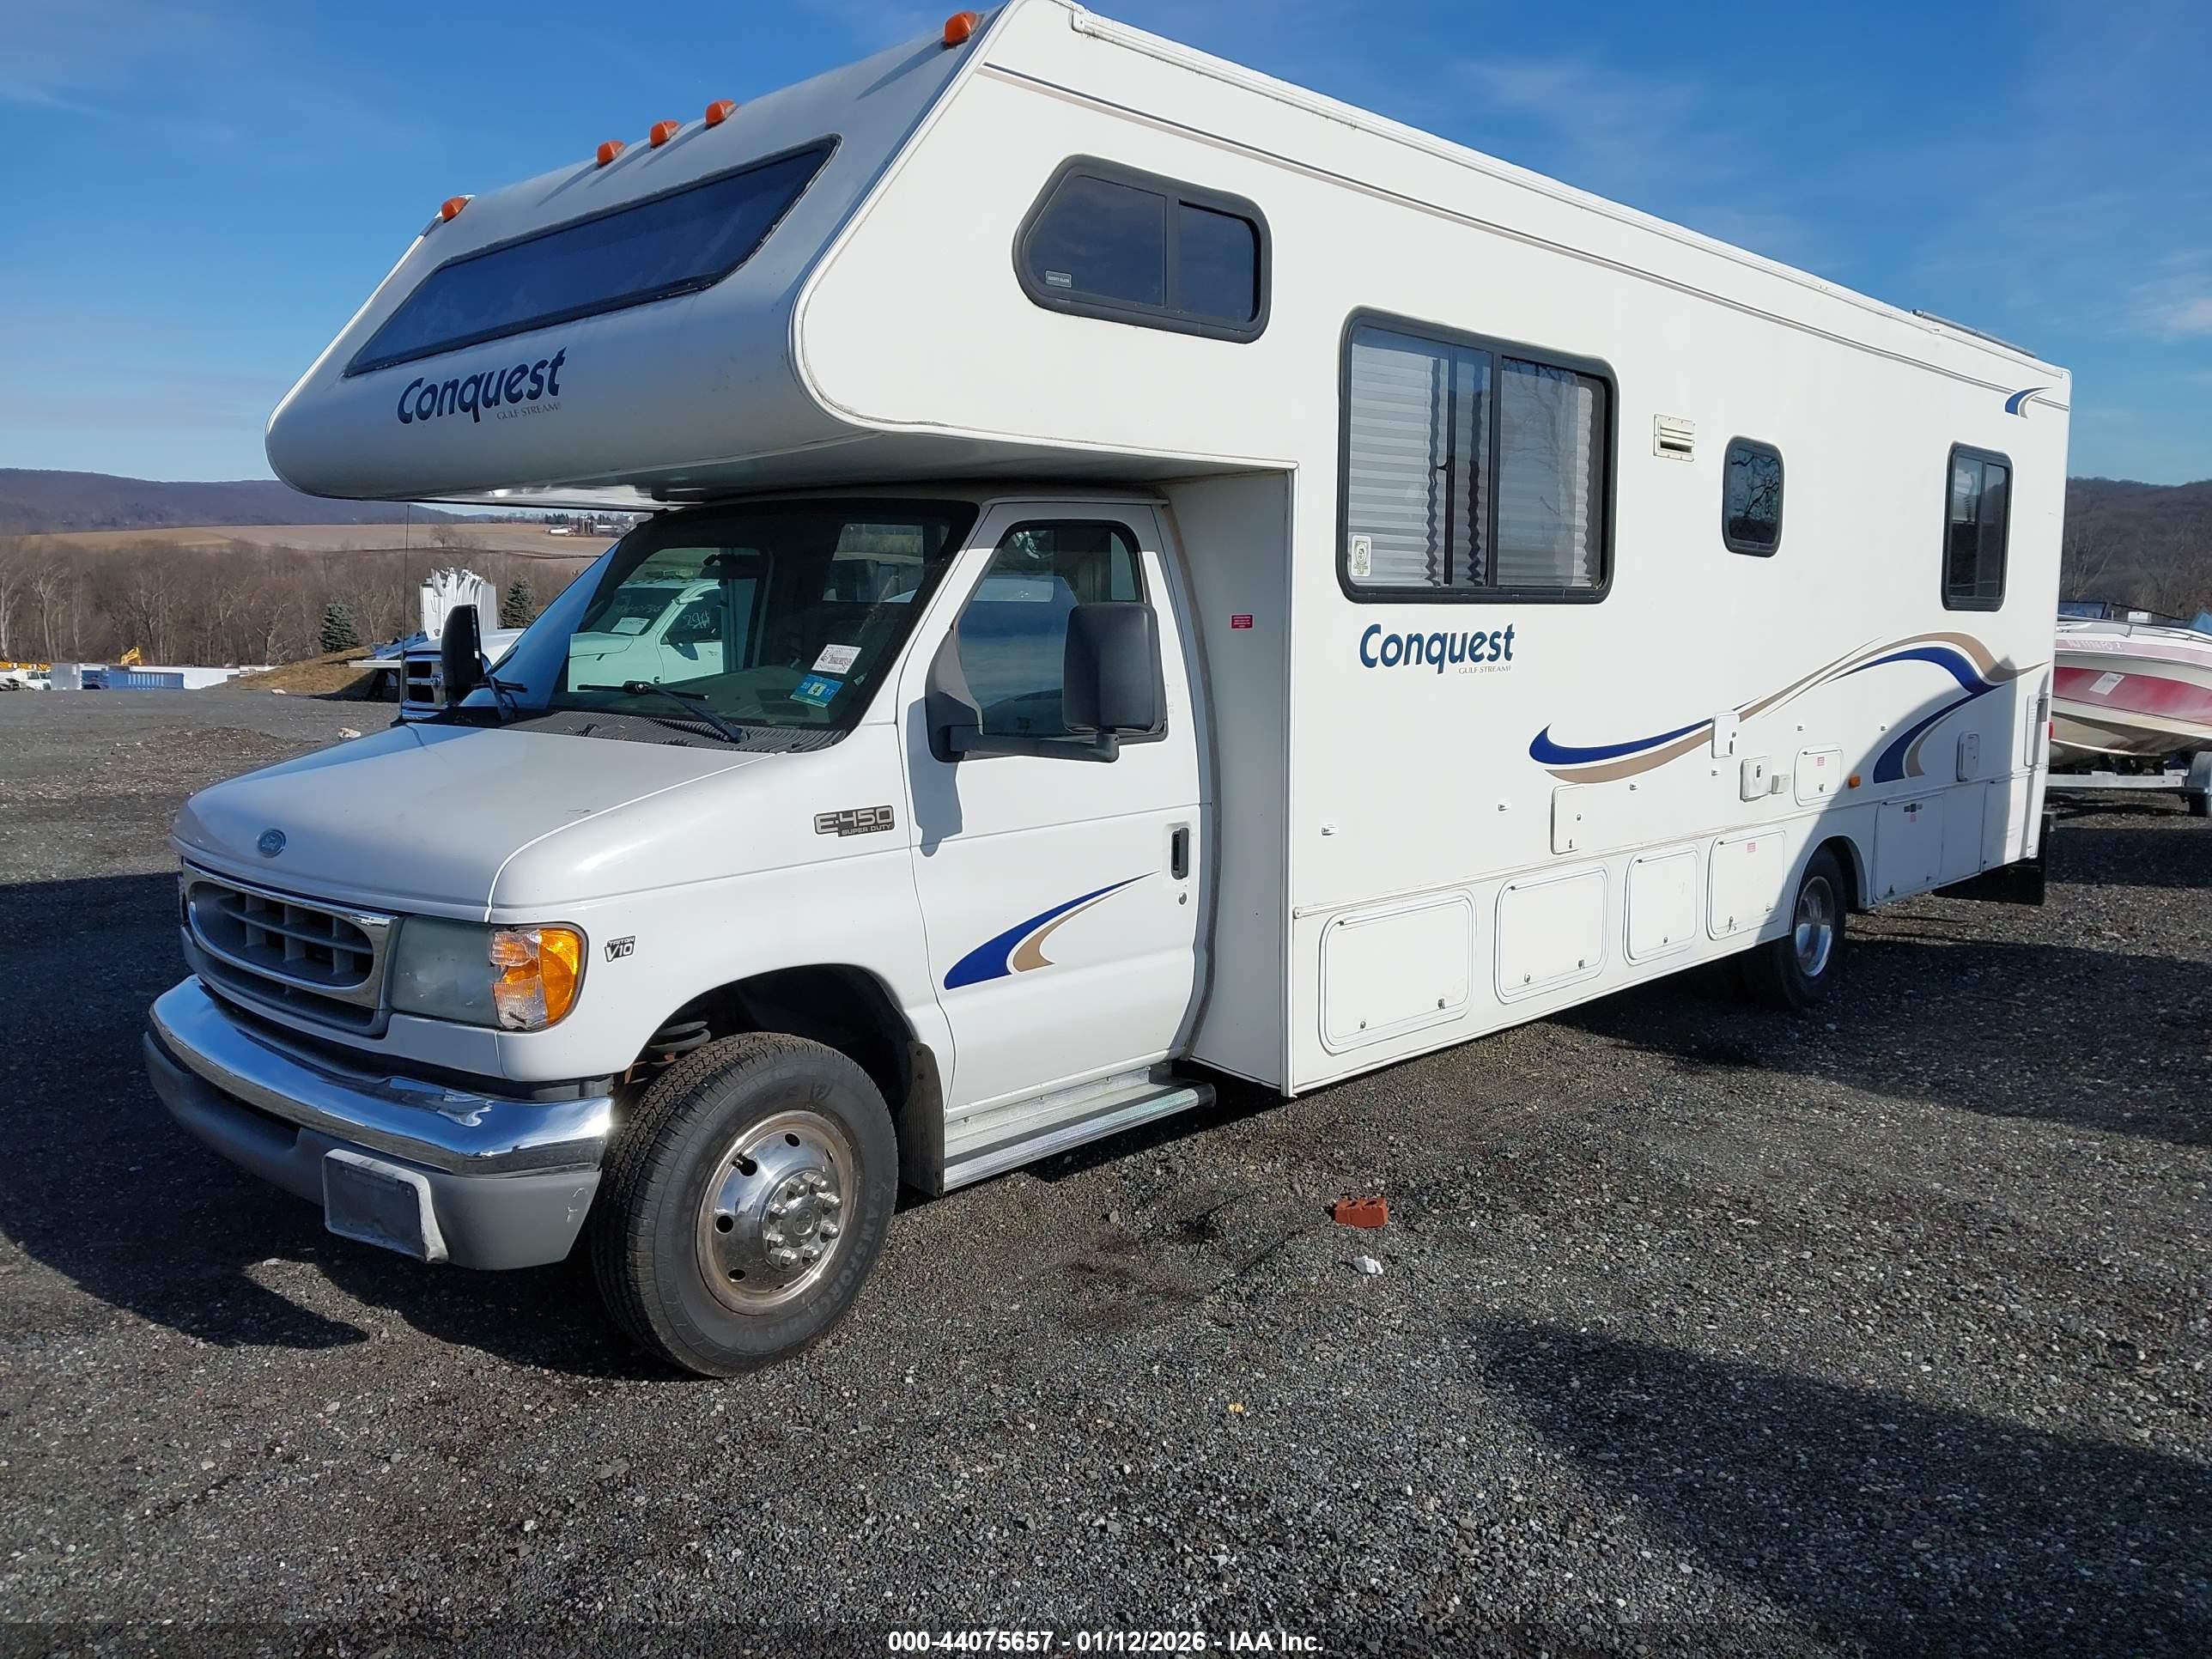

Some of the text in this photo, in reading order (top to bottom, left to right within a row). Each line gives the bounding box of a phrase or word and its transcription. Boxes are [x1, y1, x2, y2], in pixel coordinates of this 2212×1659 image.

[397, 346, 567, 424] Conquest
[496, 408, 520, 421] GULF
[1360, 623, 1516, 675] Conquest
[606, 943, 633, 961] V10
